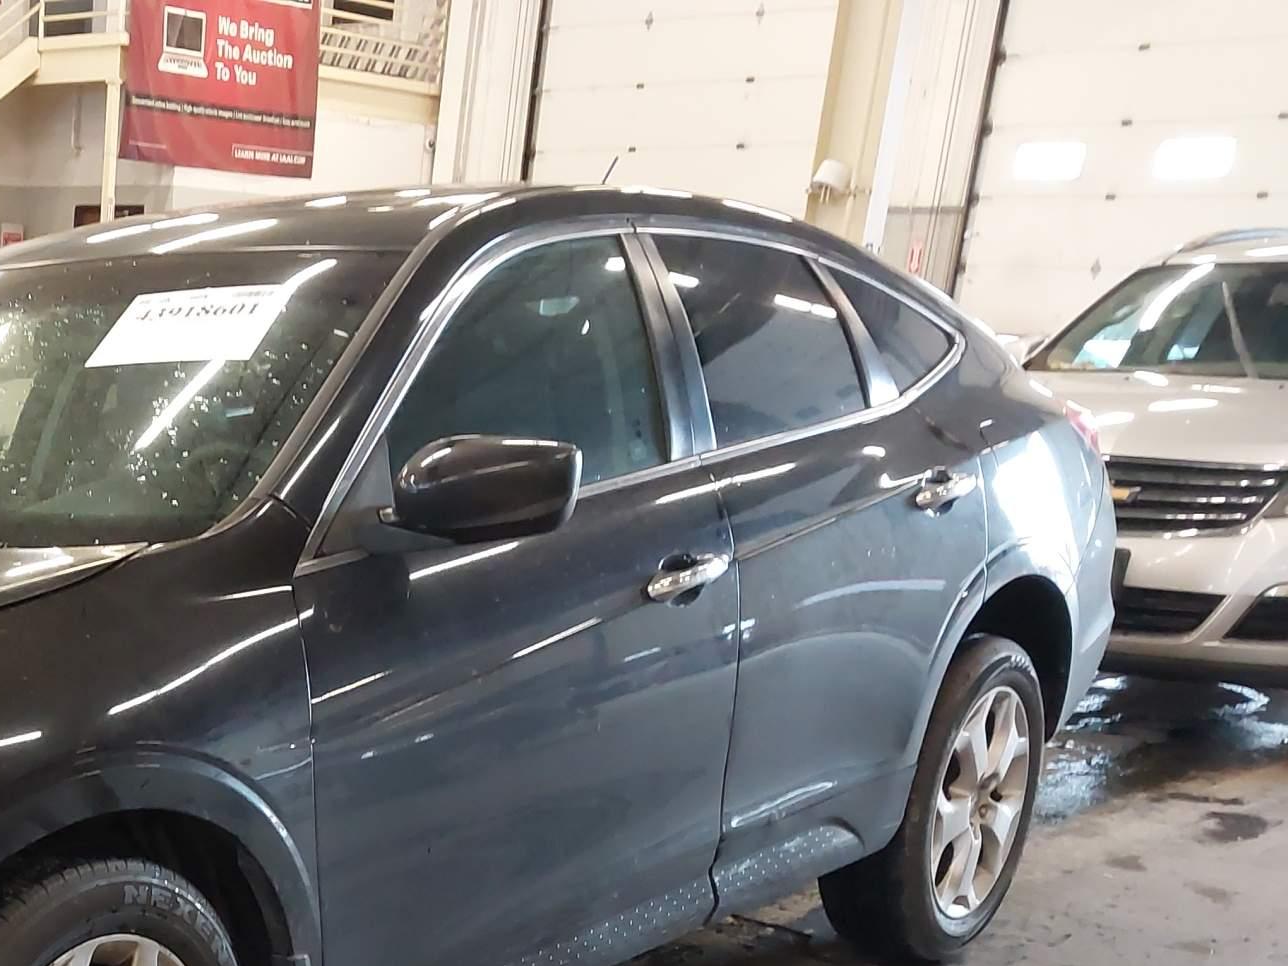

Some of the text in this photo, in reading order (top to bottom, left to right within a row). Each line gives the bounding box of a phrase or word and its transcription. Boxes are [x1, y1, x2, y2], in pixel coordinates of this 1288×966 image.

[218, 15, 274, 47] We Bring
[216, 39, 293, 69] The Auction
[215, 61, 257, 86] To You
